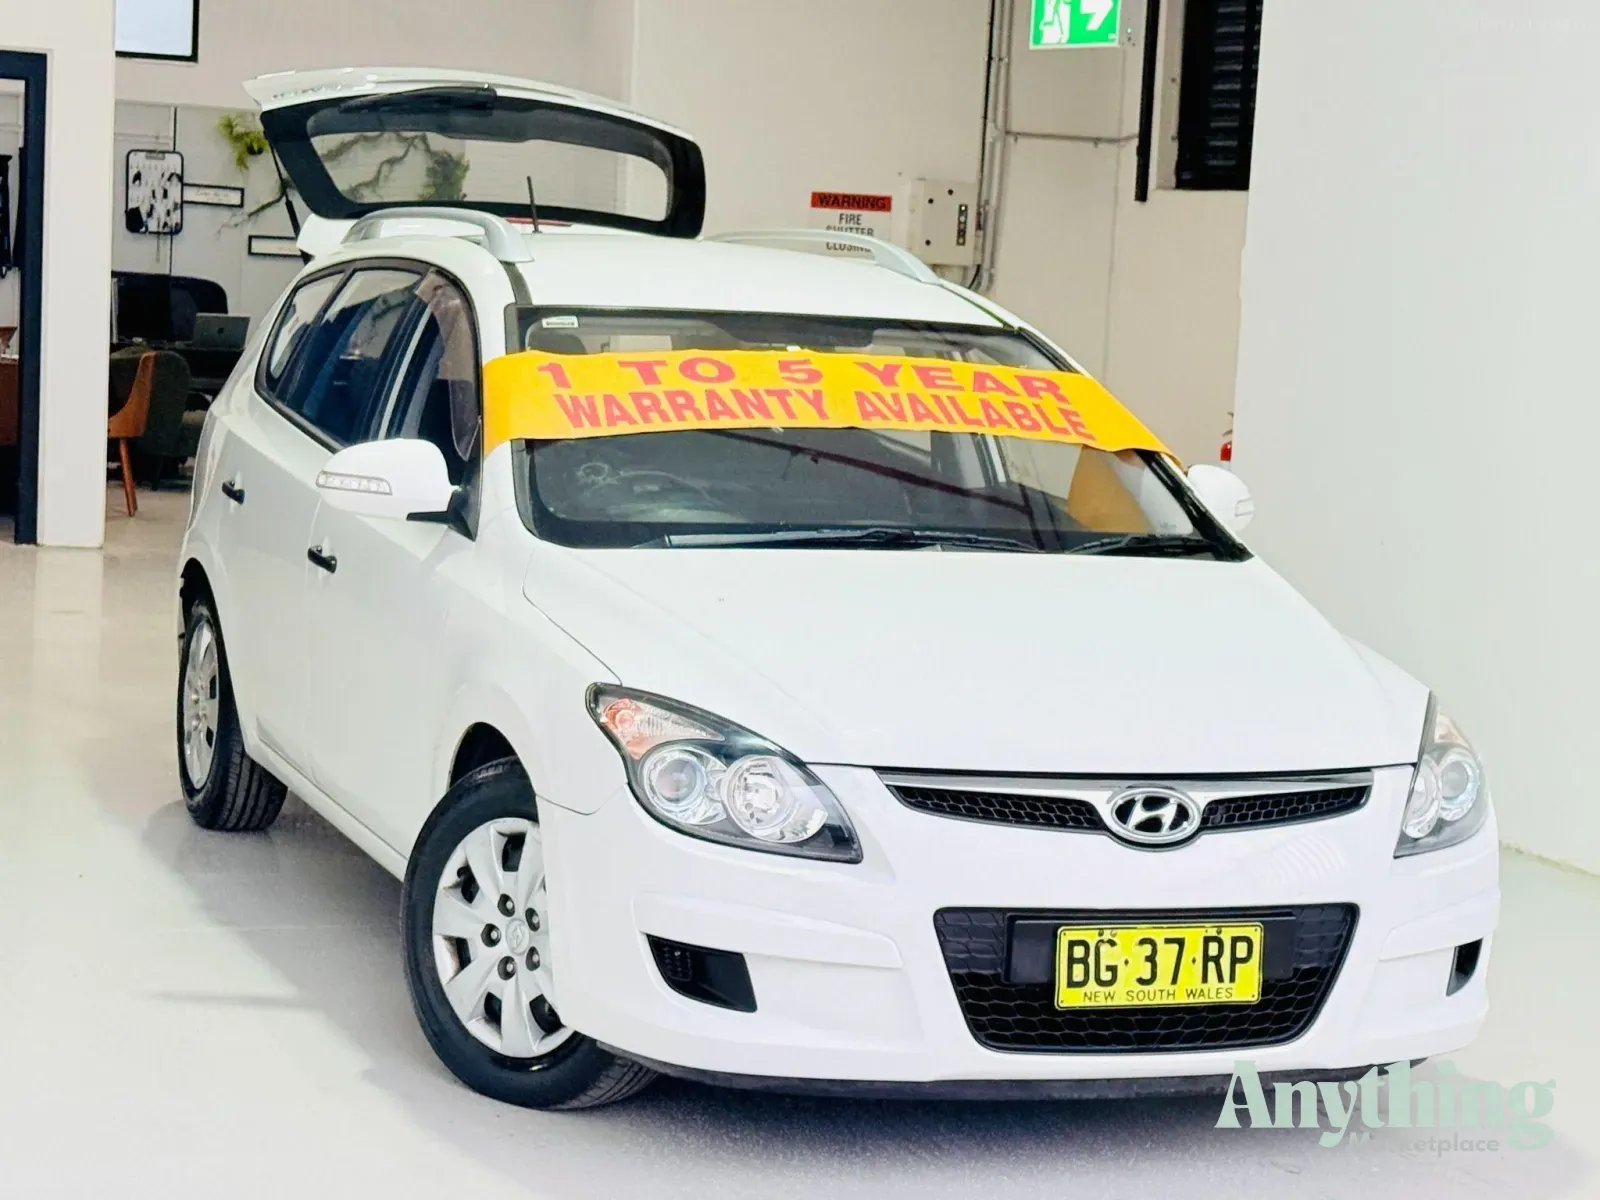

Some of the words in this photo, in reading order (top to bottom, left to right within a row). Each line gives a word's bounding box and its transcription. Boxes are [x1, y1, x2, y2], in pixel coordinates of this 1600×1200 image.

[819, 193, 887, 210] WARNING
[839, 213, 862, 225] FIRE
[537, 362, 571, 389] 1
[617, 357, 736, 386] TO
[777, 358, 824, 385] 5
[853, 361, 1072, 405] YEAR
[553, 388, 829, 429] WARRANTY
[854, 391, 1097, 441] AVAILABLE
[1083, 991, 1116, 1003] NEW
[1126, 989, 1176, 1001] SOUTH
[1186, 987, 1234, 999] WALES
